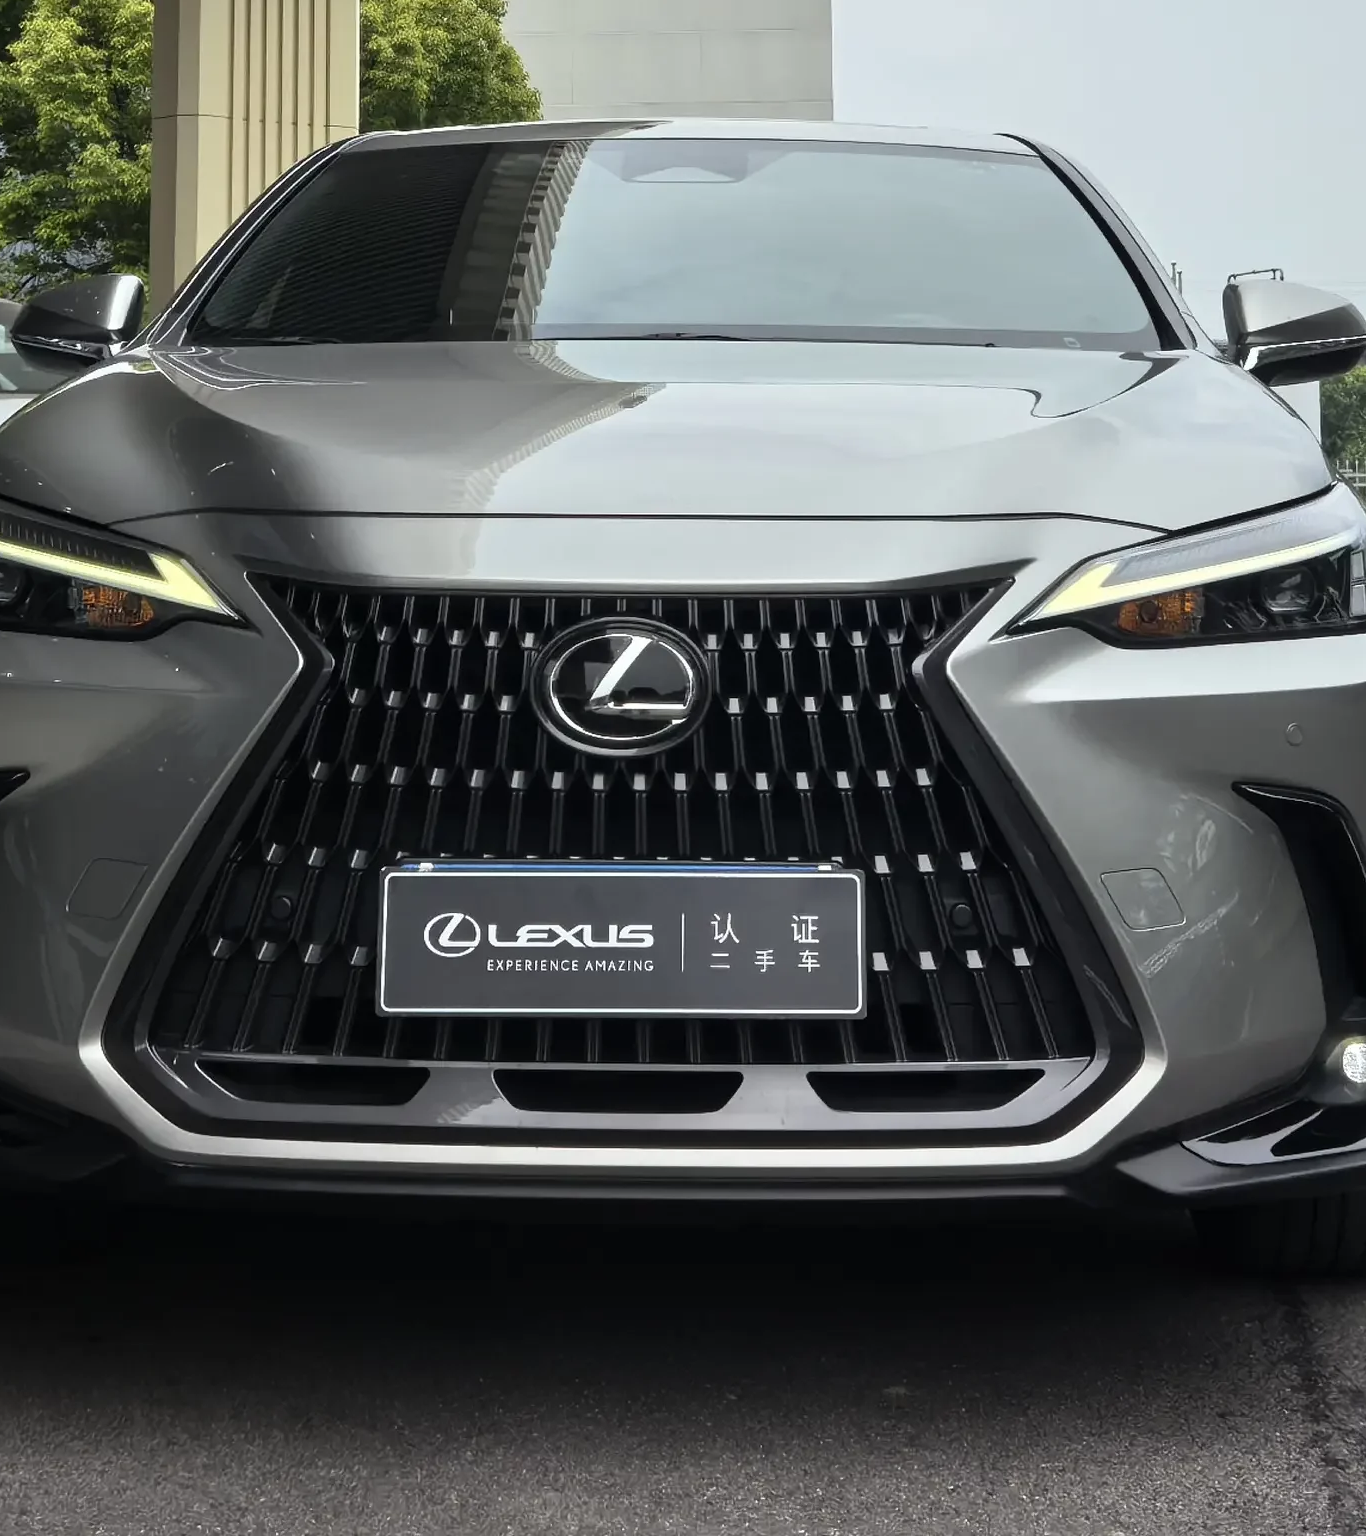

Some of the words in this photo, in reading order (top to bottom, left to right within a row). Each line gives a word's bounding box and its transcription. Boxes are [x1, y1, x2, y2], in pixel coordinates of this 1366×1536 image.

[488, 924, 654, 948] LEXUS
[711, 913, 820, 944] 认证
[487, 960, 579, 972] EXPERIENCE
[585, 960, 654, 972] AMAZING
[709, 949, 821, 973] 二手车
